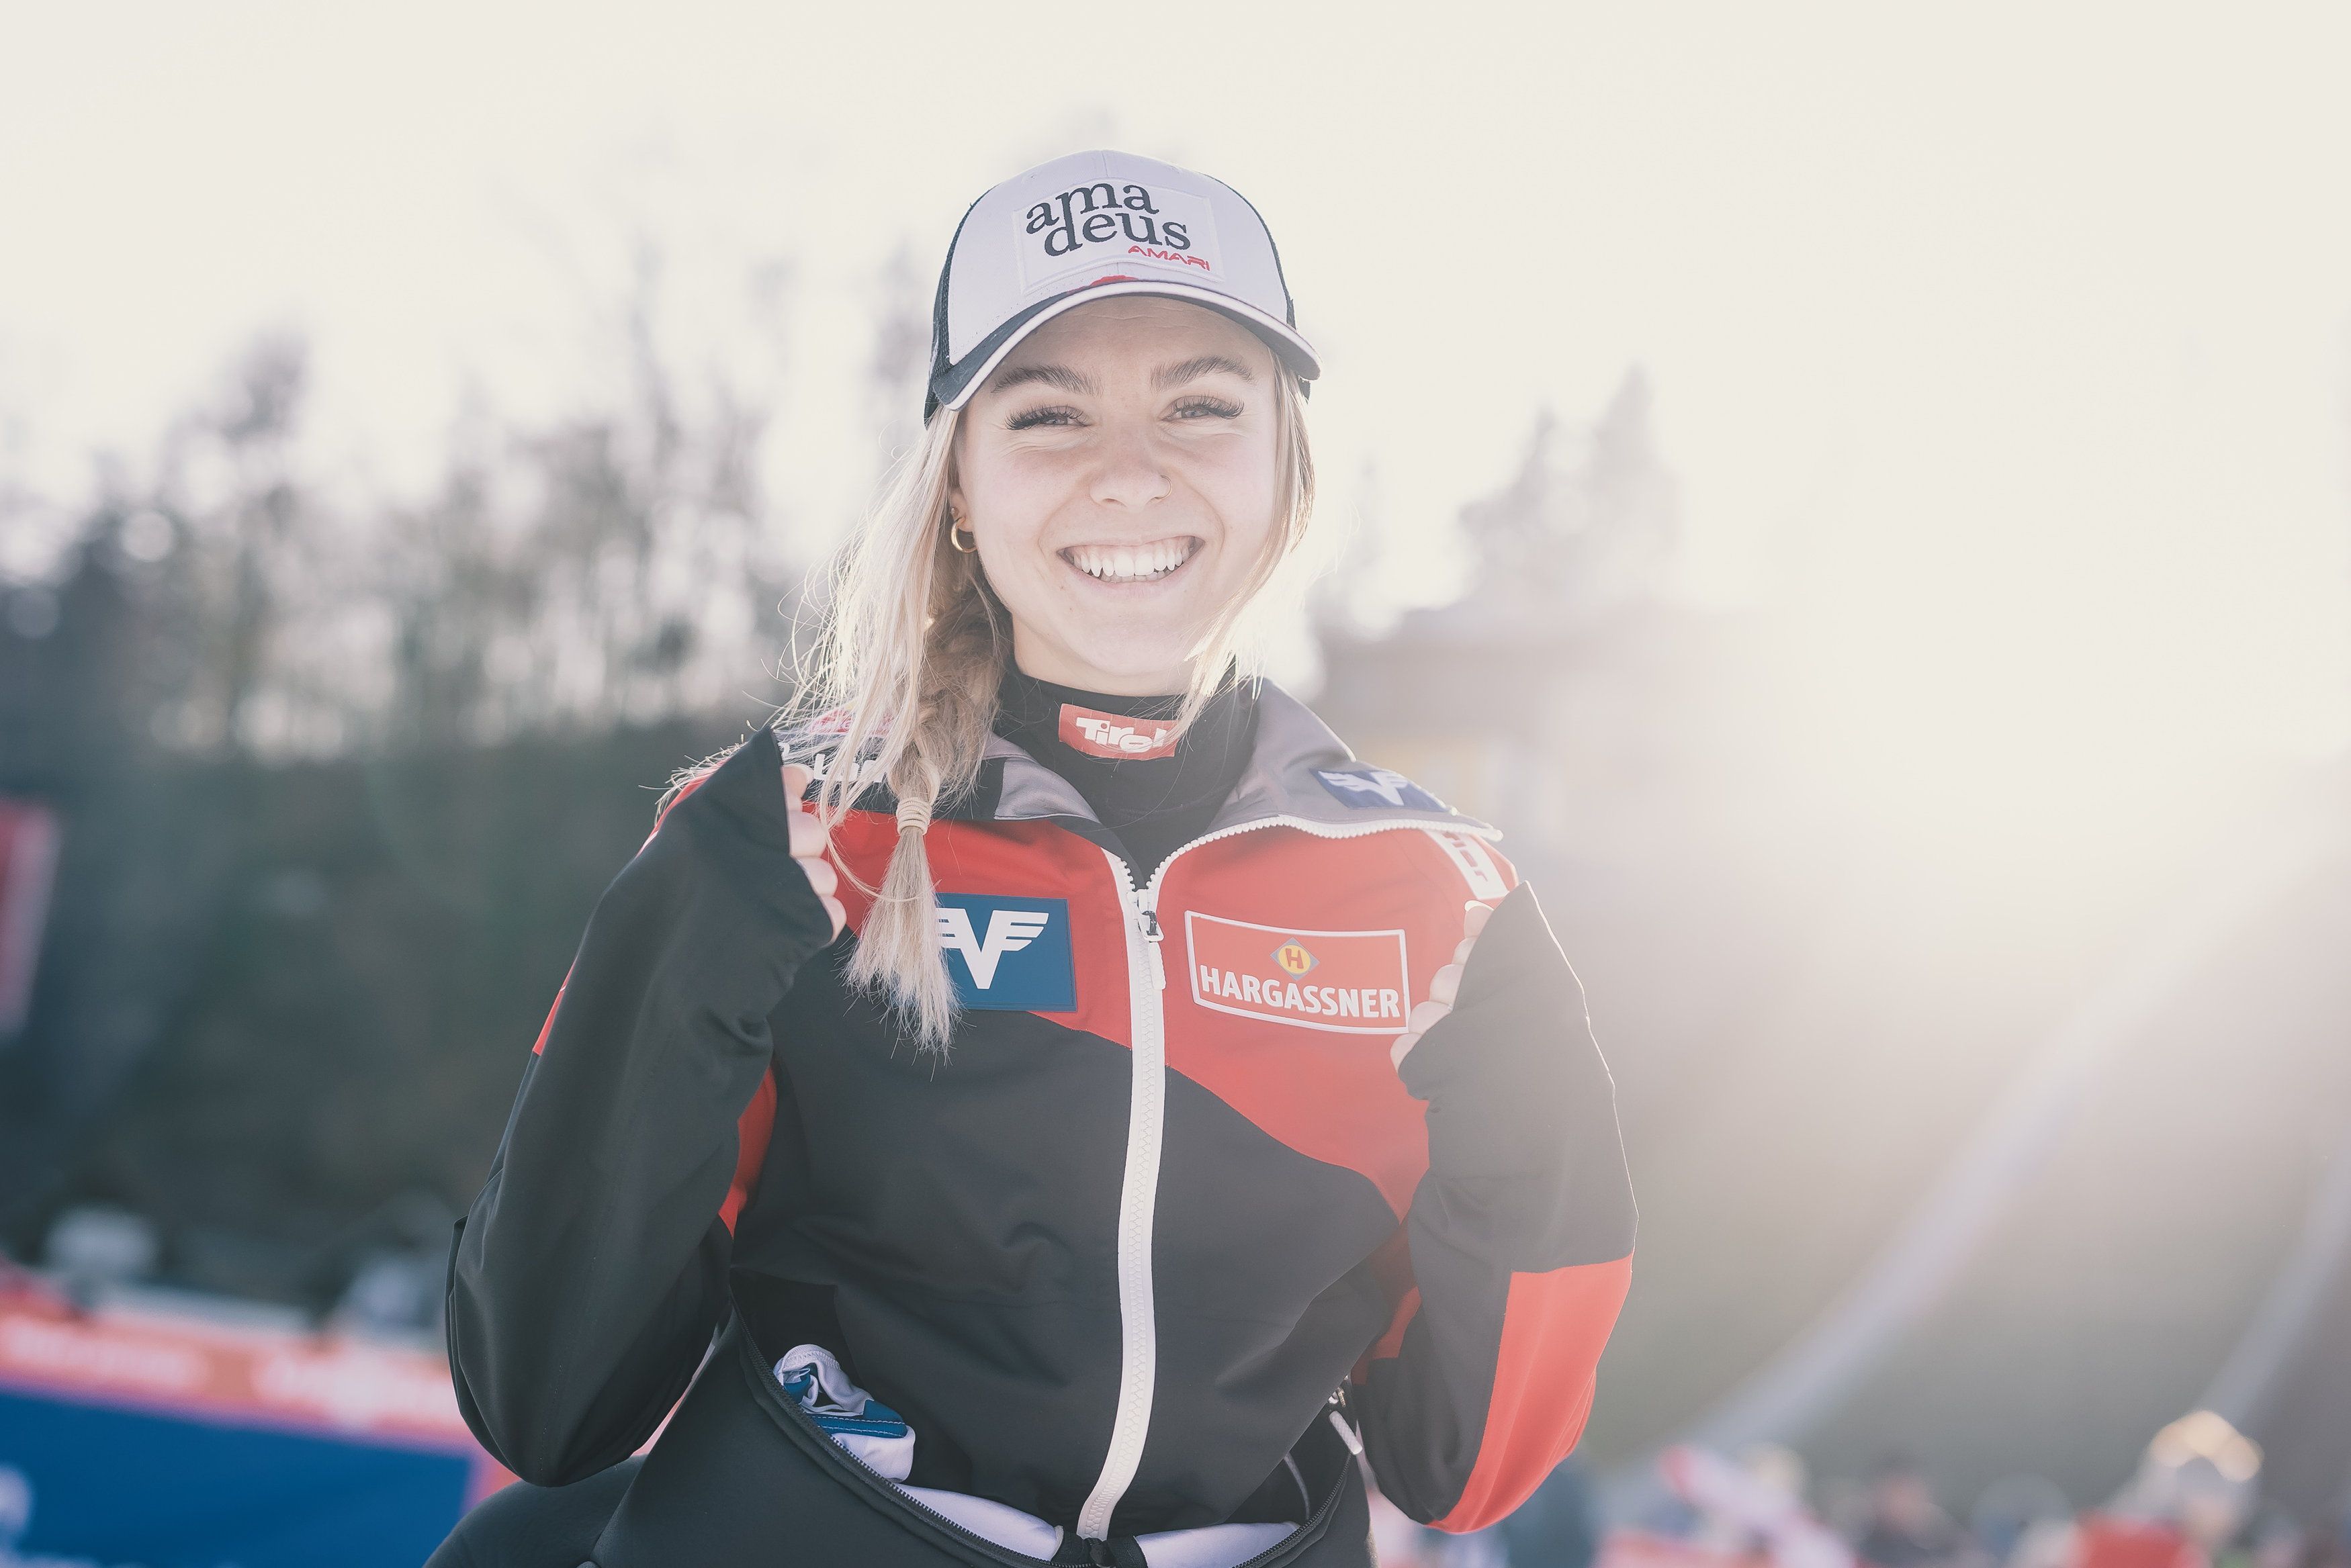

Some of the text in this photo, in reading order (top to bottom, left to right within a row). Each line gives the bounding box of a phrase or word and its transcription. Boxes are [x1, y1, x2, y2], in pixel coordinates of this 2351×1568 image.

[1026, 183, 1159, 234] ama
[1044, 195, 1191, 257] deus
[1128, 245, 1210, 271] AMARI
[1285, 947, 1304, 970] H
[1199, 964, 1401, 1018] HARGASSNER
